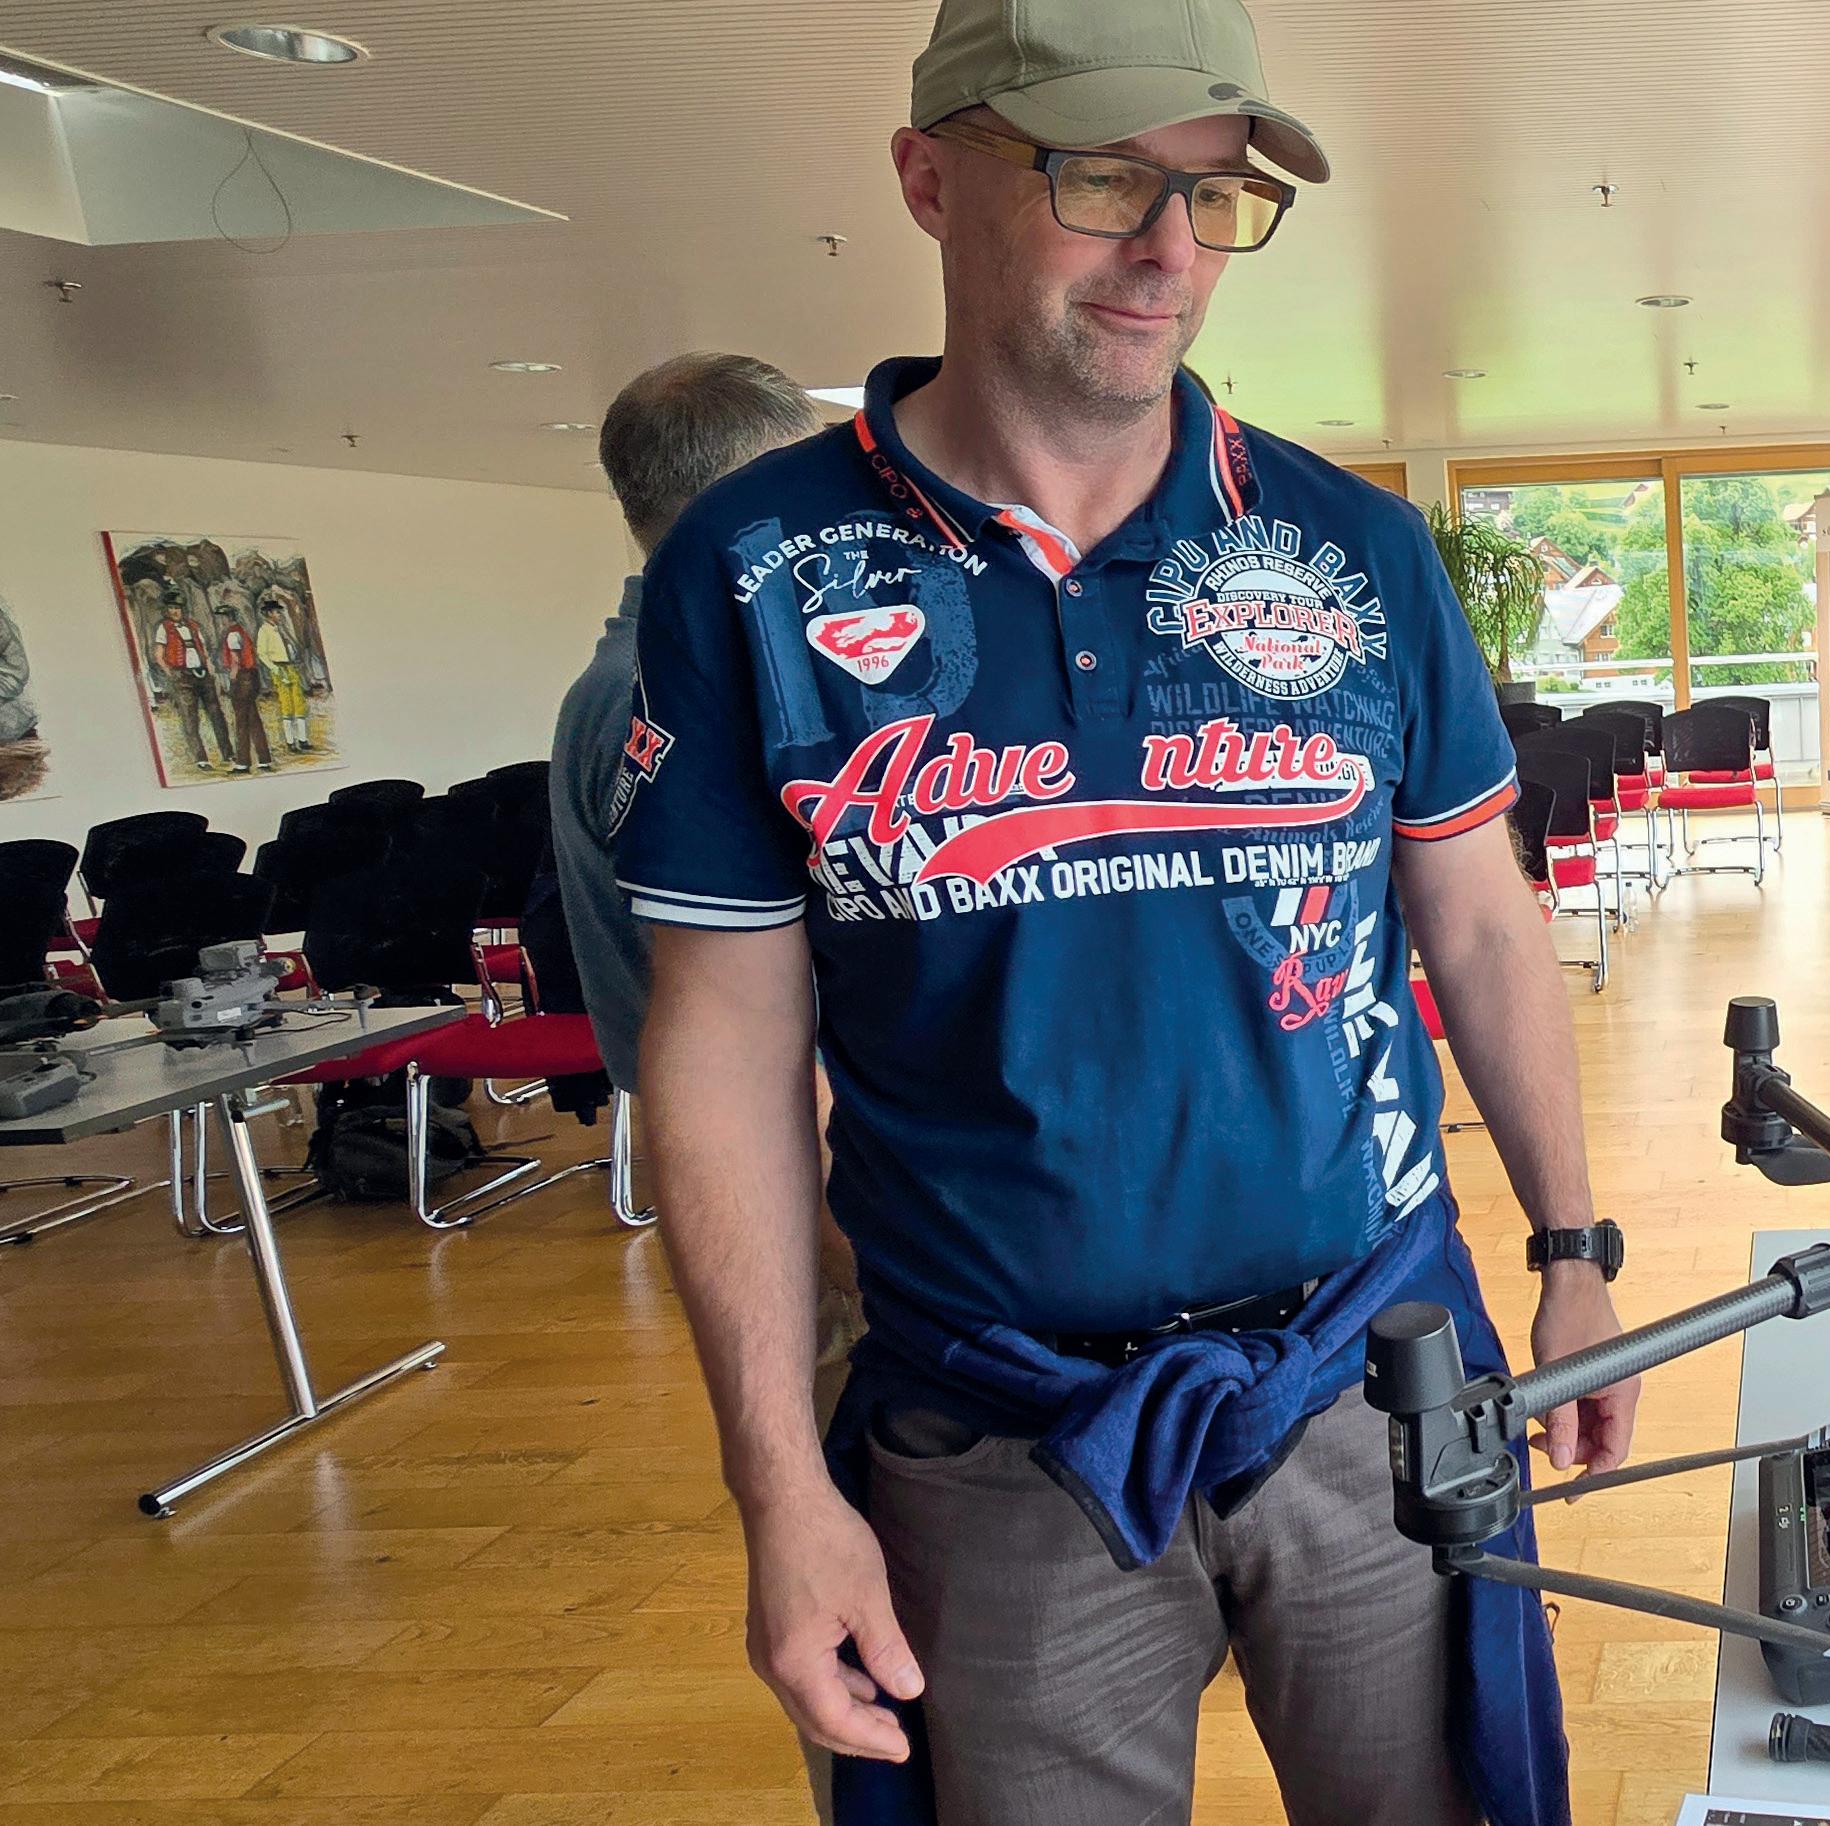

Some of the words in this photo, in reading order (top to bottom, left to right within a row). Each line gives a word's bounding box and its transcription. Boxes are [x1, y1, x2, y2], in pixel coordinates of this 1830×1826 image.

[871, 453, 908, 500] CIPO
[843, 550, 869, 561] THE
[1212, 515, 1302, 559] AND
[734, 534, 817, 604] LEADER
[819, 521, 988, 577] GENERAON
[793, 553, 922, 613] Silver
[1204, 555, 1261, 591] RHINOS
[1262, 556, 1333, 600] RESERVE
[1216, 591, 1287, 603] DISCOVERY
[1288, 595, 1324, 609] TOUR
[1183, 599, 1362, 658] EXPLORER
[1241, 635, 1322, 655] National
[857, 655, 890, 673] 1996
[1212, 640, 1290, 696] WILDERNESS
[1290, 647, 1346, 696] ADVENTURE
[1261, 654, 1305, 671] Park
[827, 893, 881, 922] CIPO
[880, 883, 941, 921] AND
[946, 864, 1045, 914] BAXX
[1051, 850, 1215, 900] ORIGINAL
[1222, 842, 1324, 884] DENIM
[1332, 837, 1382, 876] BRAND
[1290, 919, 1343, 953] NYC
